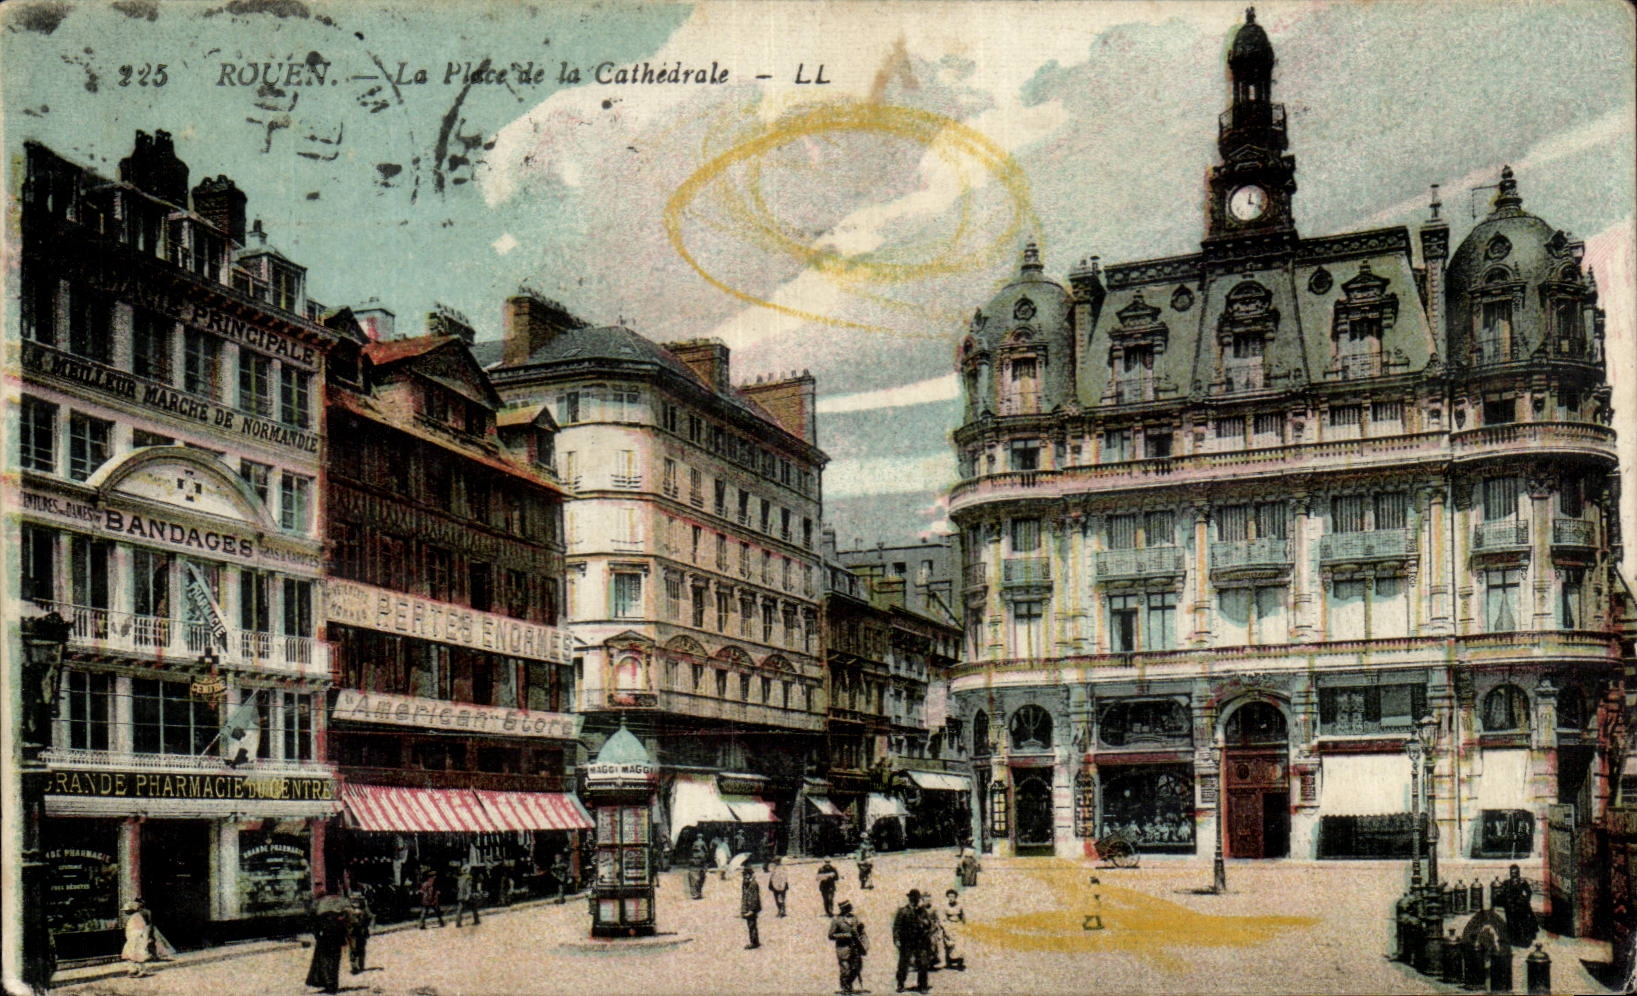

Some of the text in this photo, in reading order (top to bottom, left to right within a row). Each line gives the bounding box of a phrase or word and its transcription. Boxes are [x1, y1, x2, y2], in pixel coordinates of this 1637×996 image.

[192, 303, 317, 364] PRINCIPALE
[214, 407, 234, 429] DE
[242, 419, 319, 453] NORMANDIE
[105, 508, 253, 558] BANDAGES
[136, 775, 244, 799] PHARMACIE
[249, 783, 266, 797] DU
[268, 778, 332, 800] CENTRE
[590, 765, 618, 774] MAGGI
